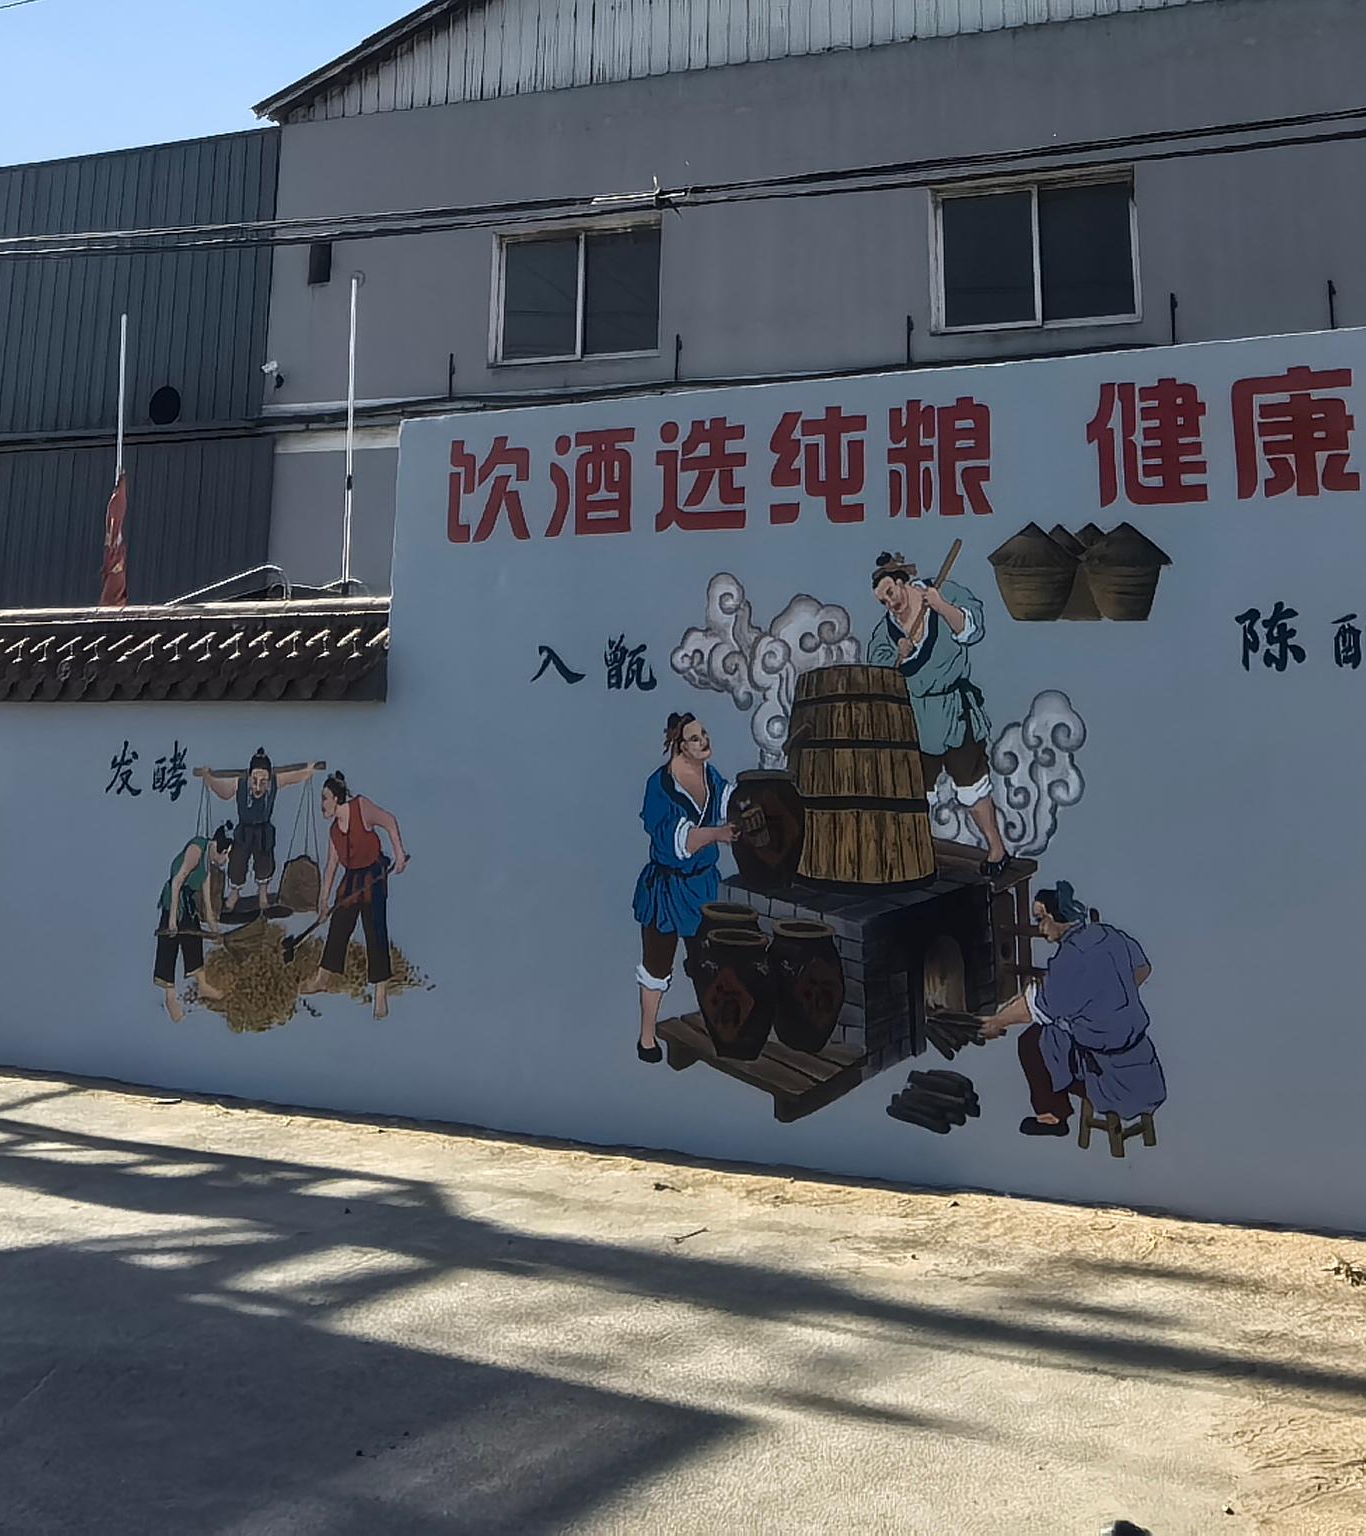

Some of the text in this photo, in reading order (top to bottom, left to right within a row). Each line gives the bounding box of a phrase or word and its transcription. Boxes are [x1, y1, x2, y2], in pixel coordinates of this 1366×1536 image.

[446, 395, 993, 544] 饮酒选纯粮
[531, 633, 658, 692] 入甑
[104, 738, 190, 803] 发酵
